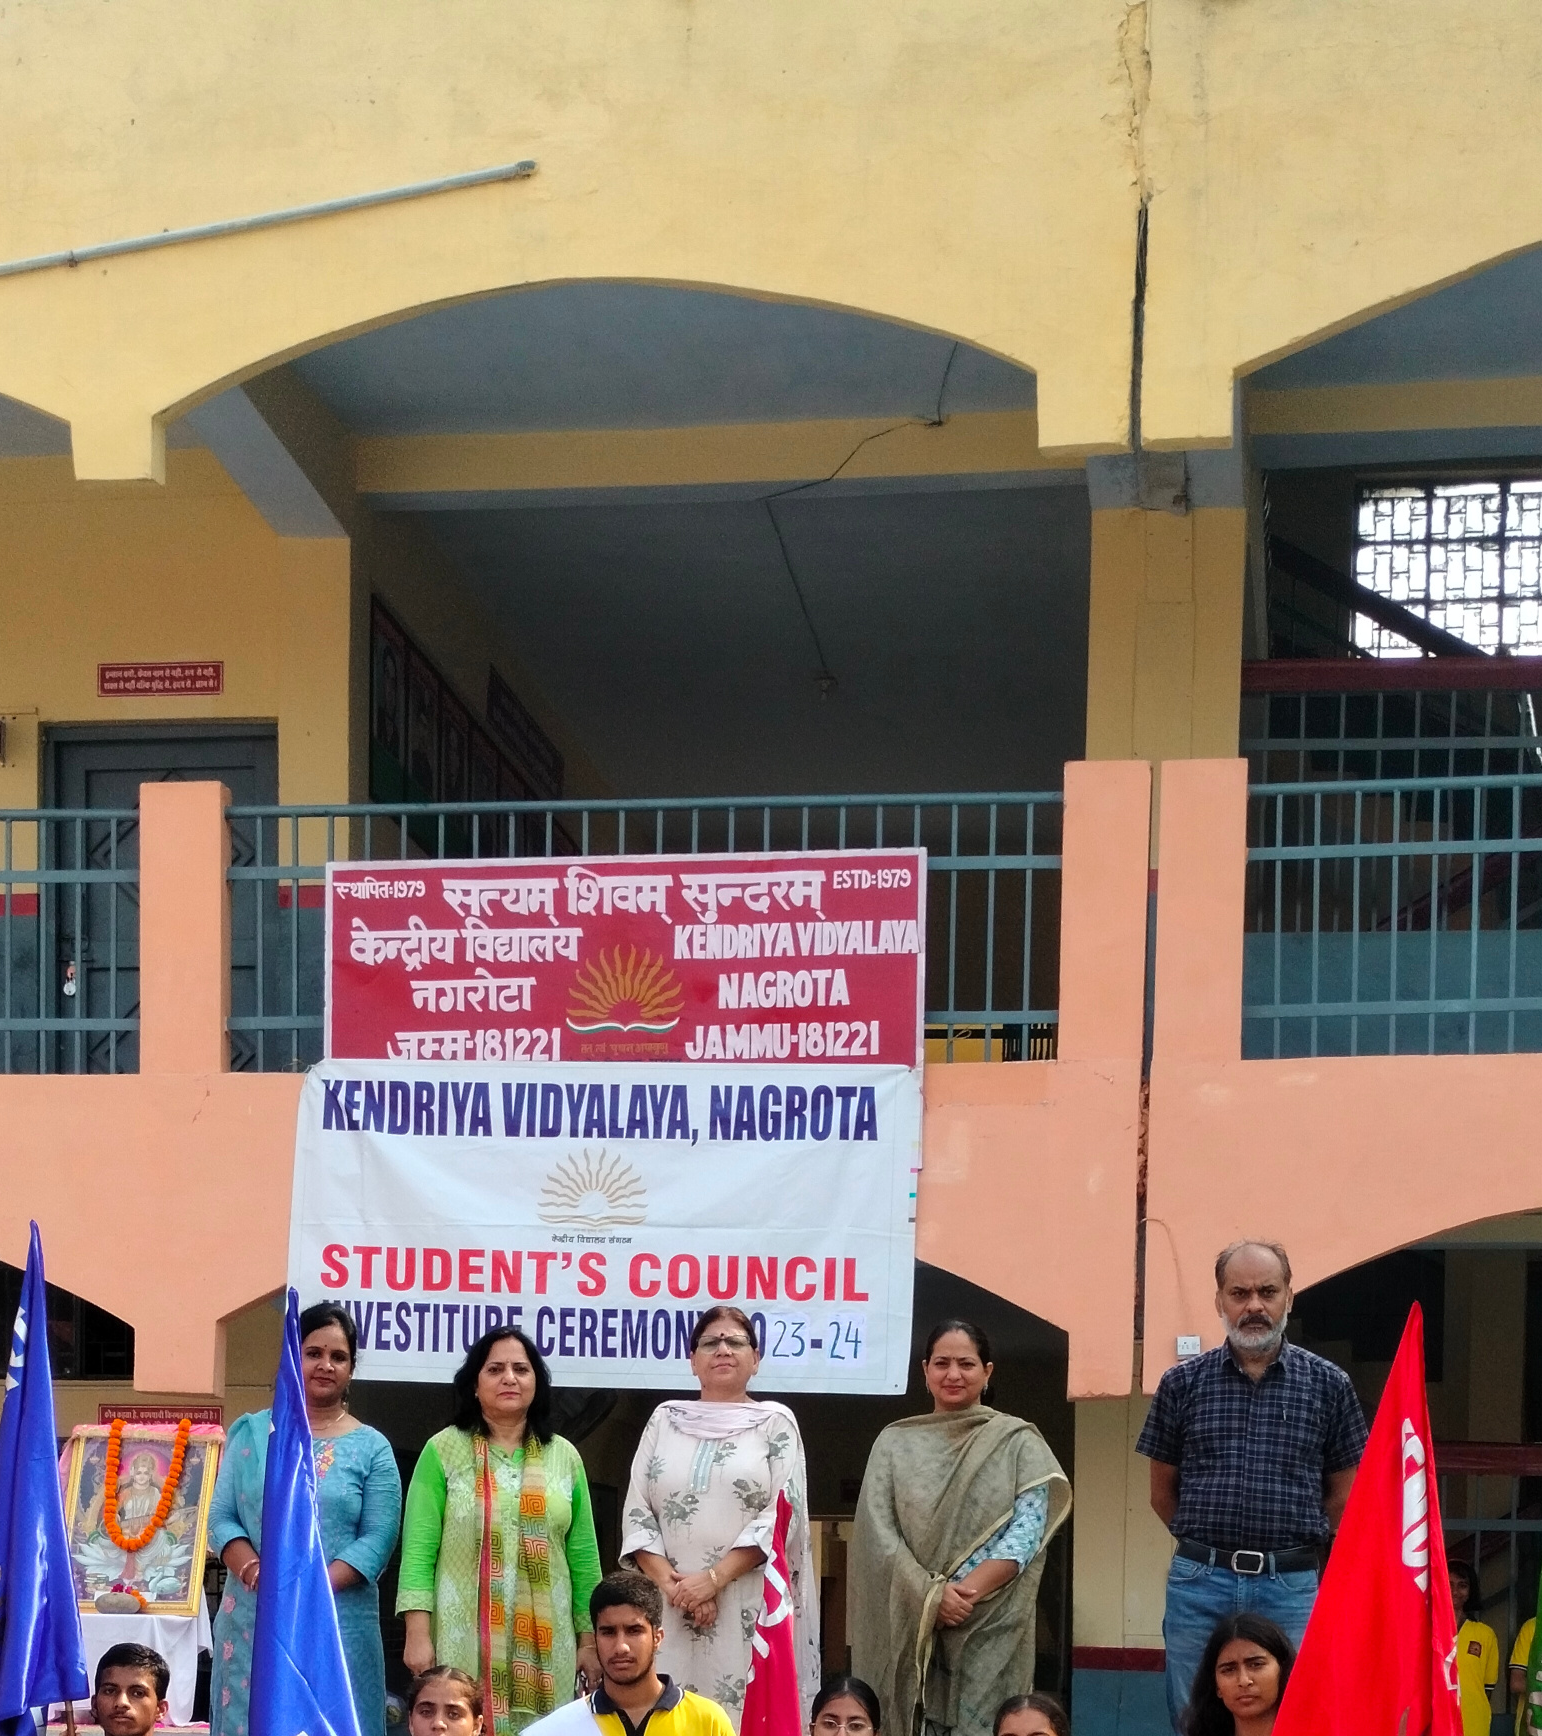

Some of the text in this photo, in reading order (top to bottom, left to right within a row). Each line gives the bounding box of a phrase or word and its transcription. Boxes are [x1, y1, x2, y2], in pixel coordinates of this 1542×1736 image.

[441, 866, 826, 927] सत्यम् शिवम् सुन्दरम्
[350, 915, 584, 971] केन्द्रीय विद्यालय
[674, 919, 922, 960] KENDRIYA VIDYALAYA
[409, 967, 537, 1013] नगरोटा
[718, 968, 850, 1009] NAGROTA
[685, 1020, 880, 1060] JAMMU-181221
[321, 1079, 878, 1147] KENDRIYA VIDYALAYA, NAGROTA
[320, 1243, 869, 1302] STUDENT'S COUNCIL
[535, 1305, 702, 1361] CEREMON
